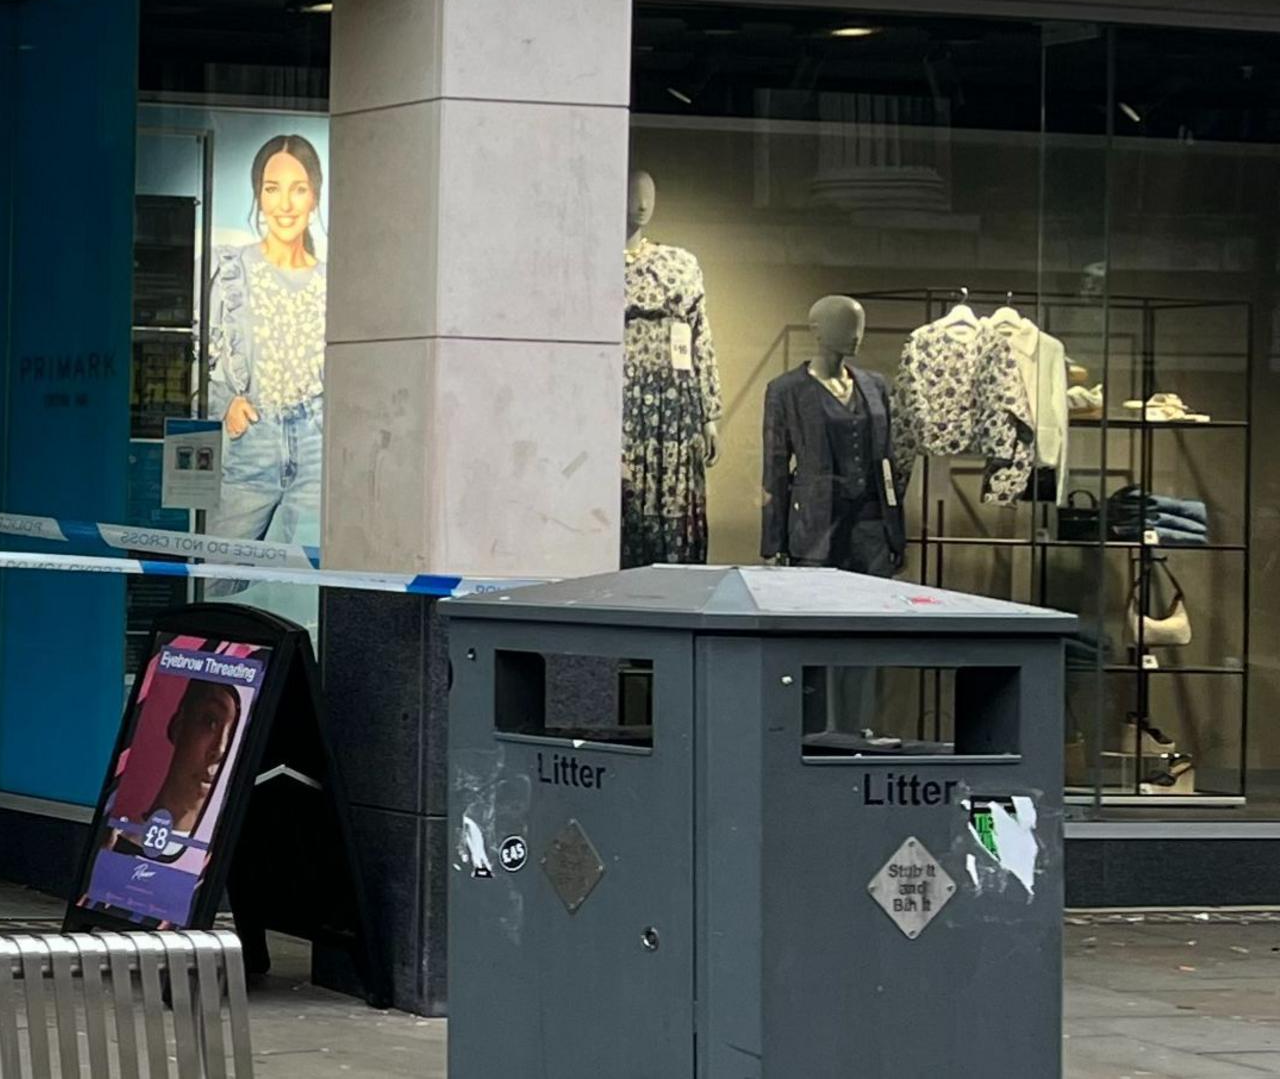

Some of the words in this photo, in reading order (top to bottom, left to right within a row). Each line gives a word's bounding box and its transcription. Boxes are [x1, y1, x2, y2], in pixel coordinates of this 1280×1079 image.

[161, 651, 204, 673] Eyebrow
[205, 658, 257, 683] Threading
[537, 753, 607, 789] Litter
[863, 773, 959, 807] Litter
[144, 826, 168, 849] £8
[888, 864, 923, 878] Stub
[899, 880, 927, 896] and
[893, 897, 917, 912] Bin
